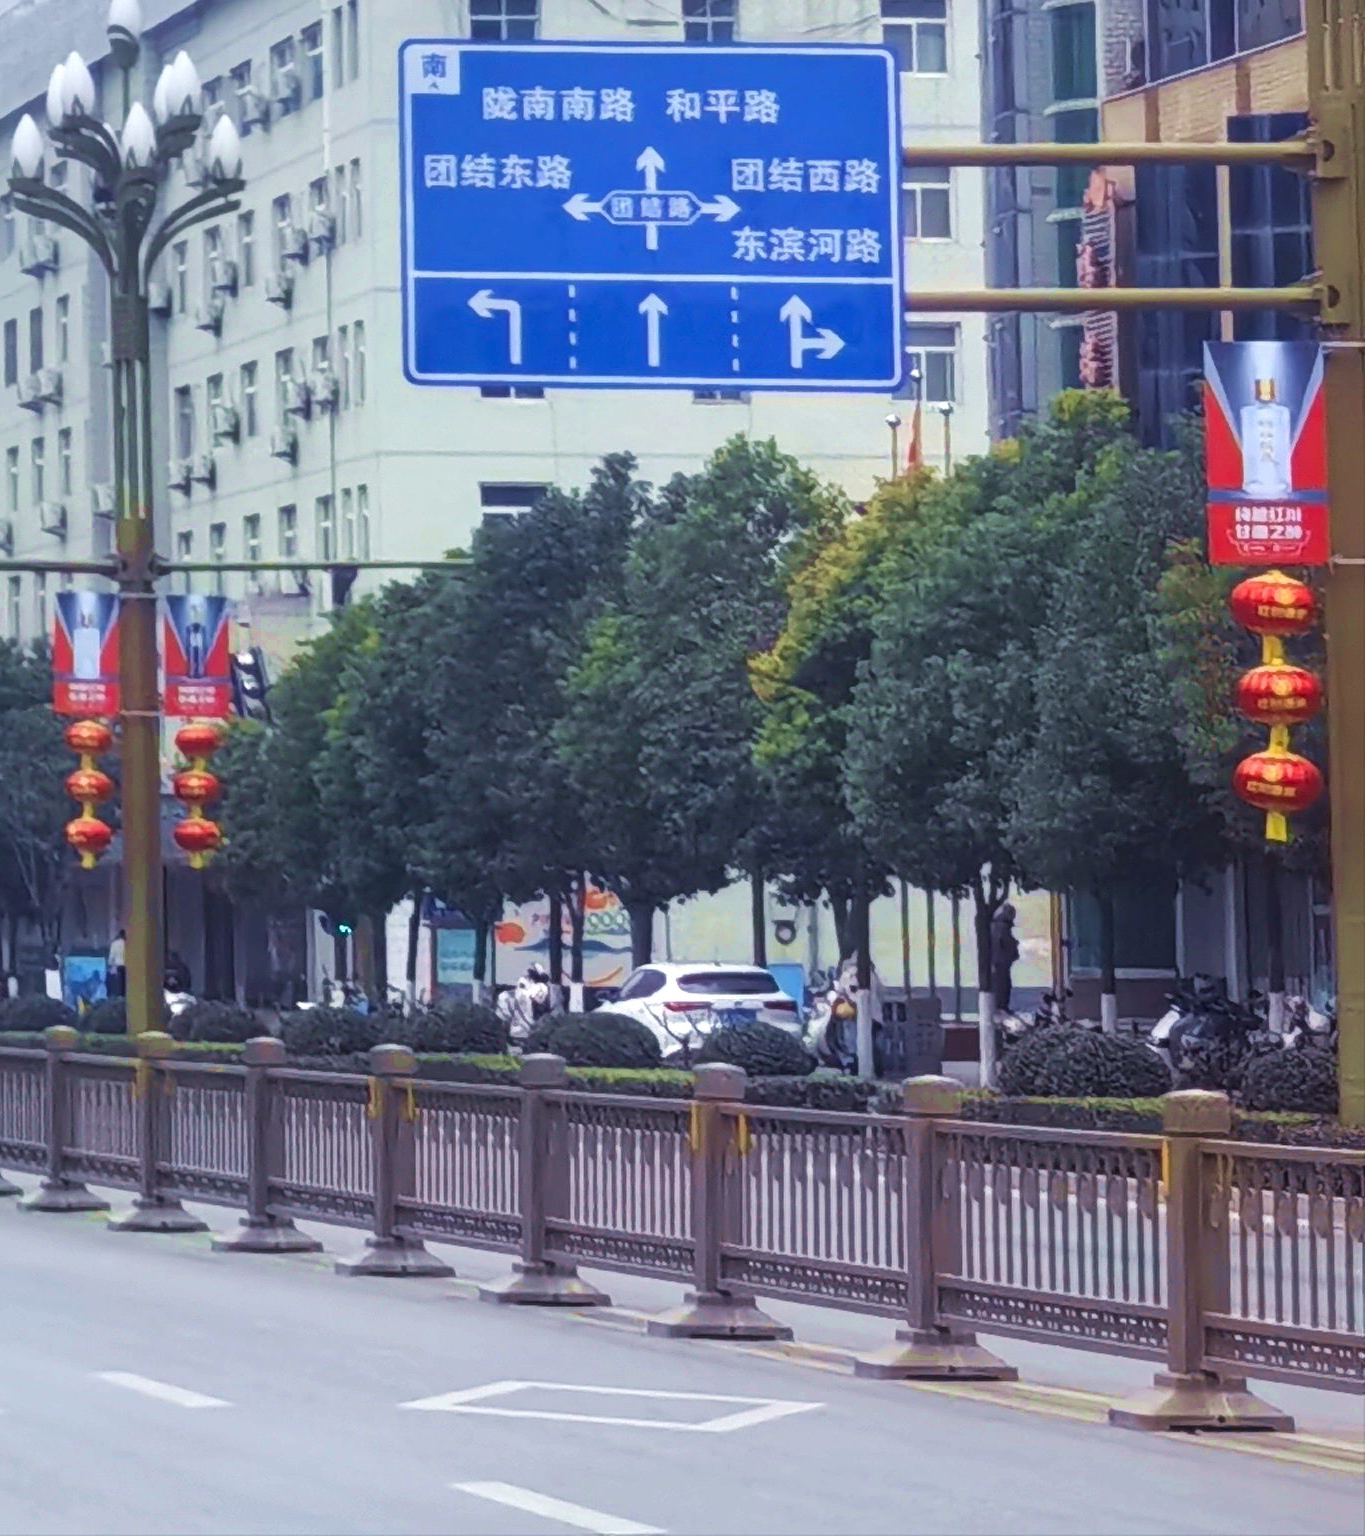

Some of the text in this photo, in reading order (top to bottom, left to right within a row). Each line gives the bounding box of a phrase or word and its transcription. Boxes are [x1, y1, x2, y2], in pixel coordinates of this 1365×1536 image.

[420, 52, 448, 79] 南
[482, 86, 780, 123] 陇南南路 和平路
[424, 153, 573, 189] 团结东路
[731, 157, 881, 194] 团结西路
[732, 226, 882, 263] 东滨河路
